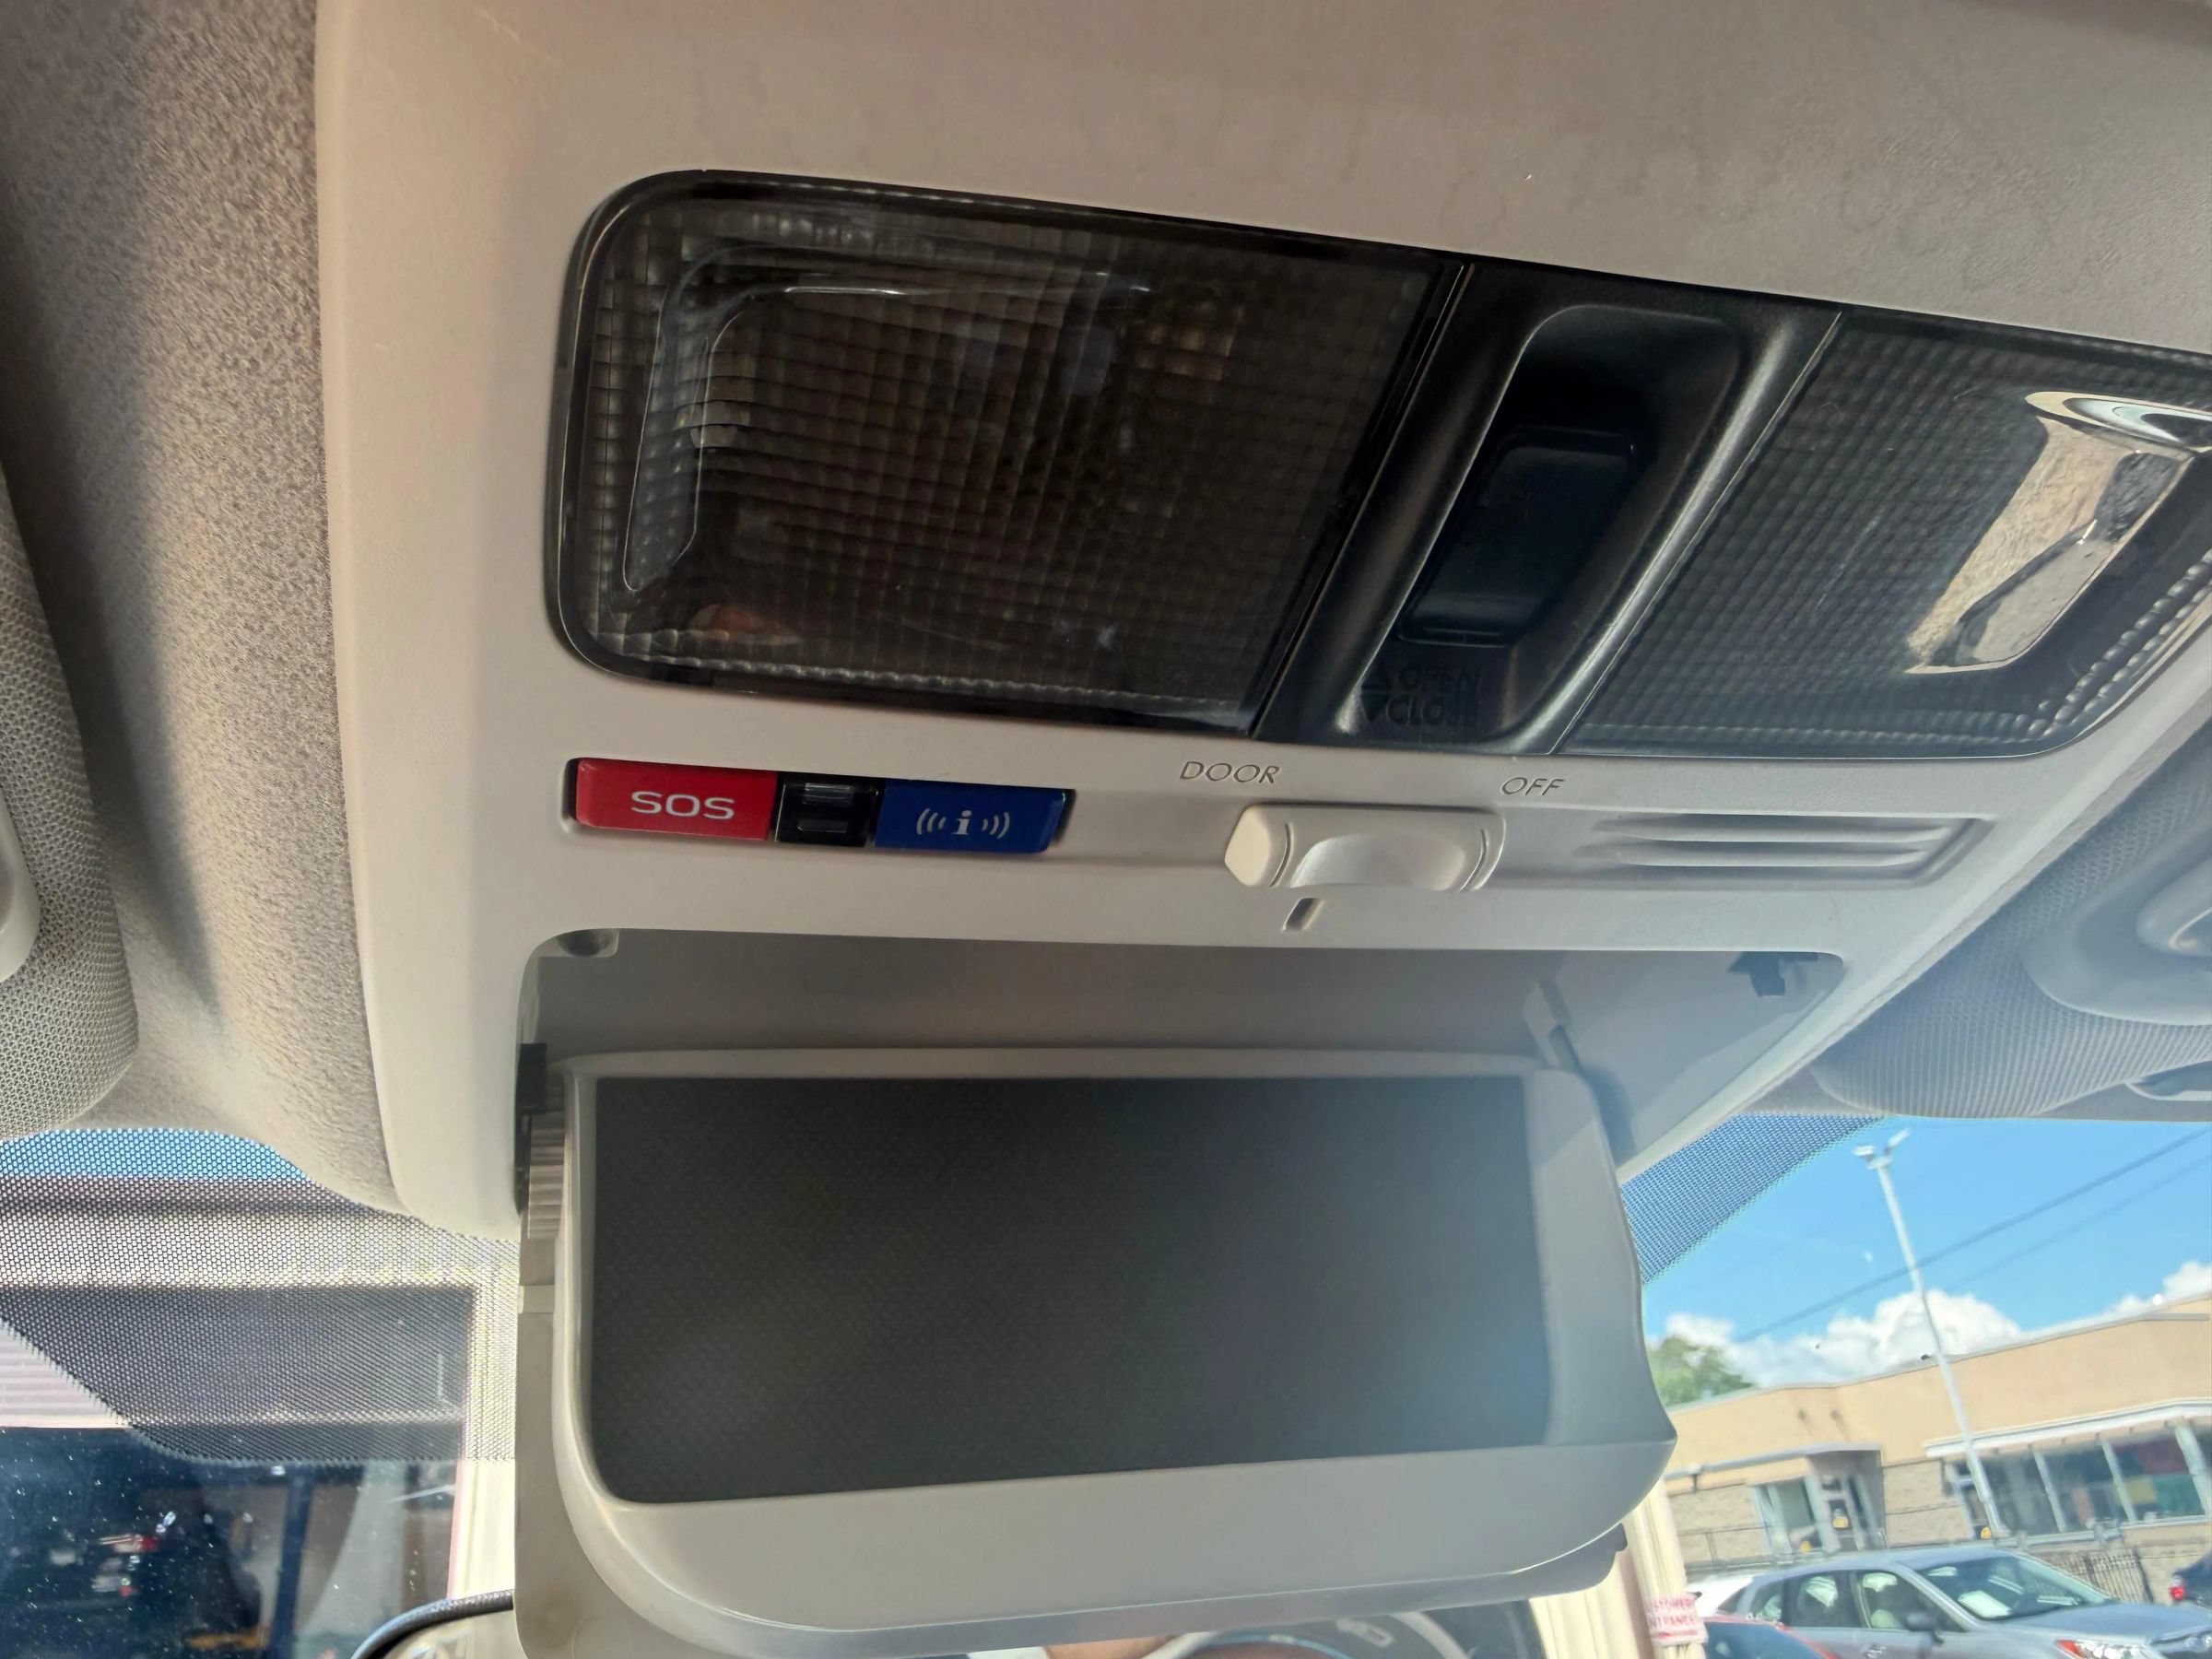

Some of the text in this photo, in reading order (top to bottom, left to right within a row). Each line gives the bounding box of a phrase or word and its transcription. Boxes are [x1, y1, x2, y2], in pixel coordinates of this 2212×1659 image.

[1179, 760, 1281, 785] DOOR
[1500, 776, 1565, 796] OFF
[630, 791, 735, 820] SOS
